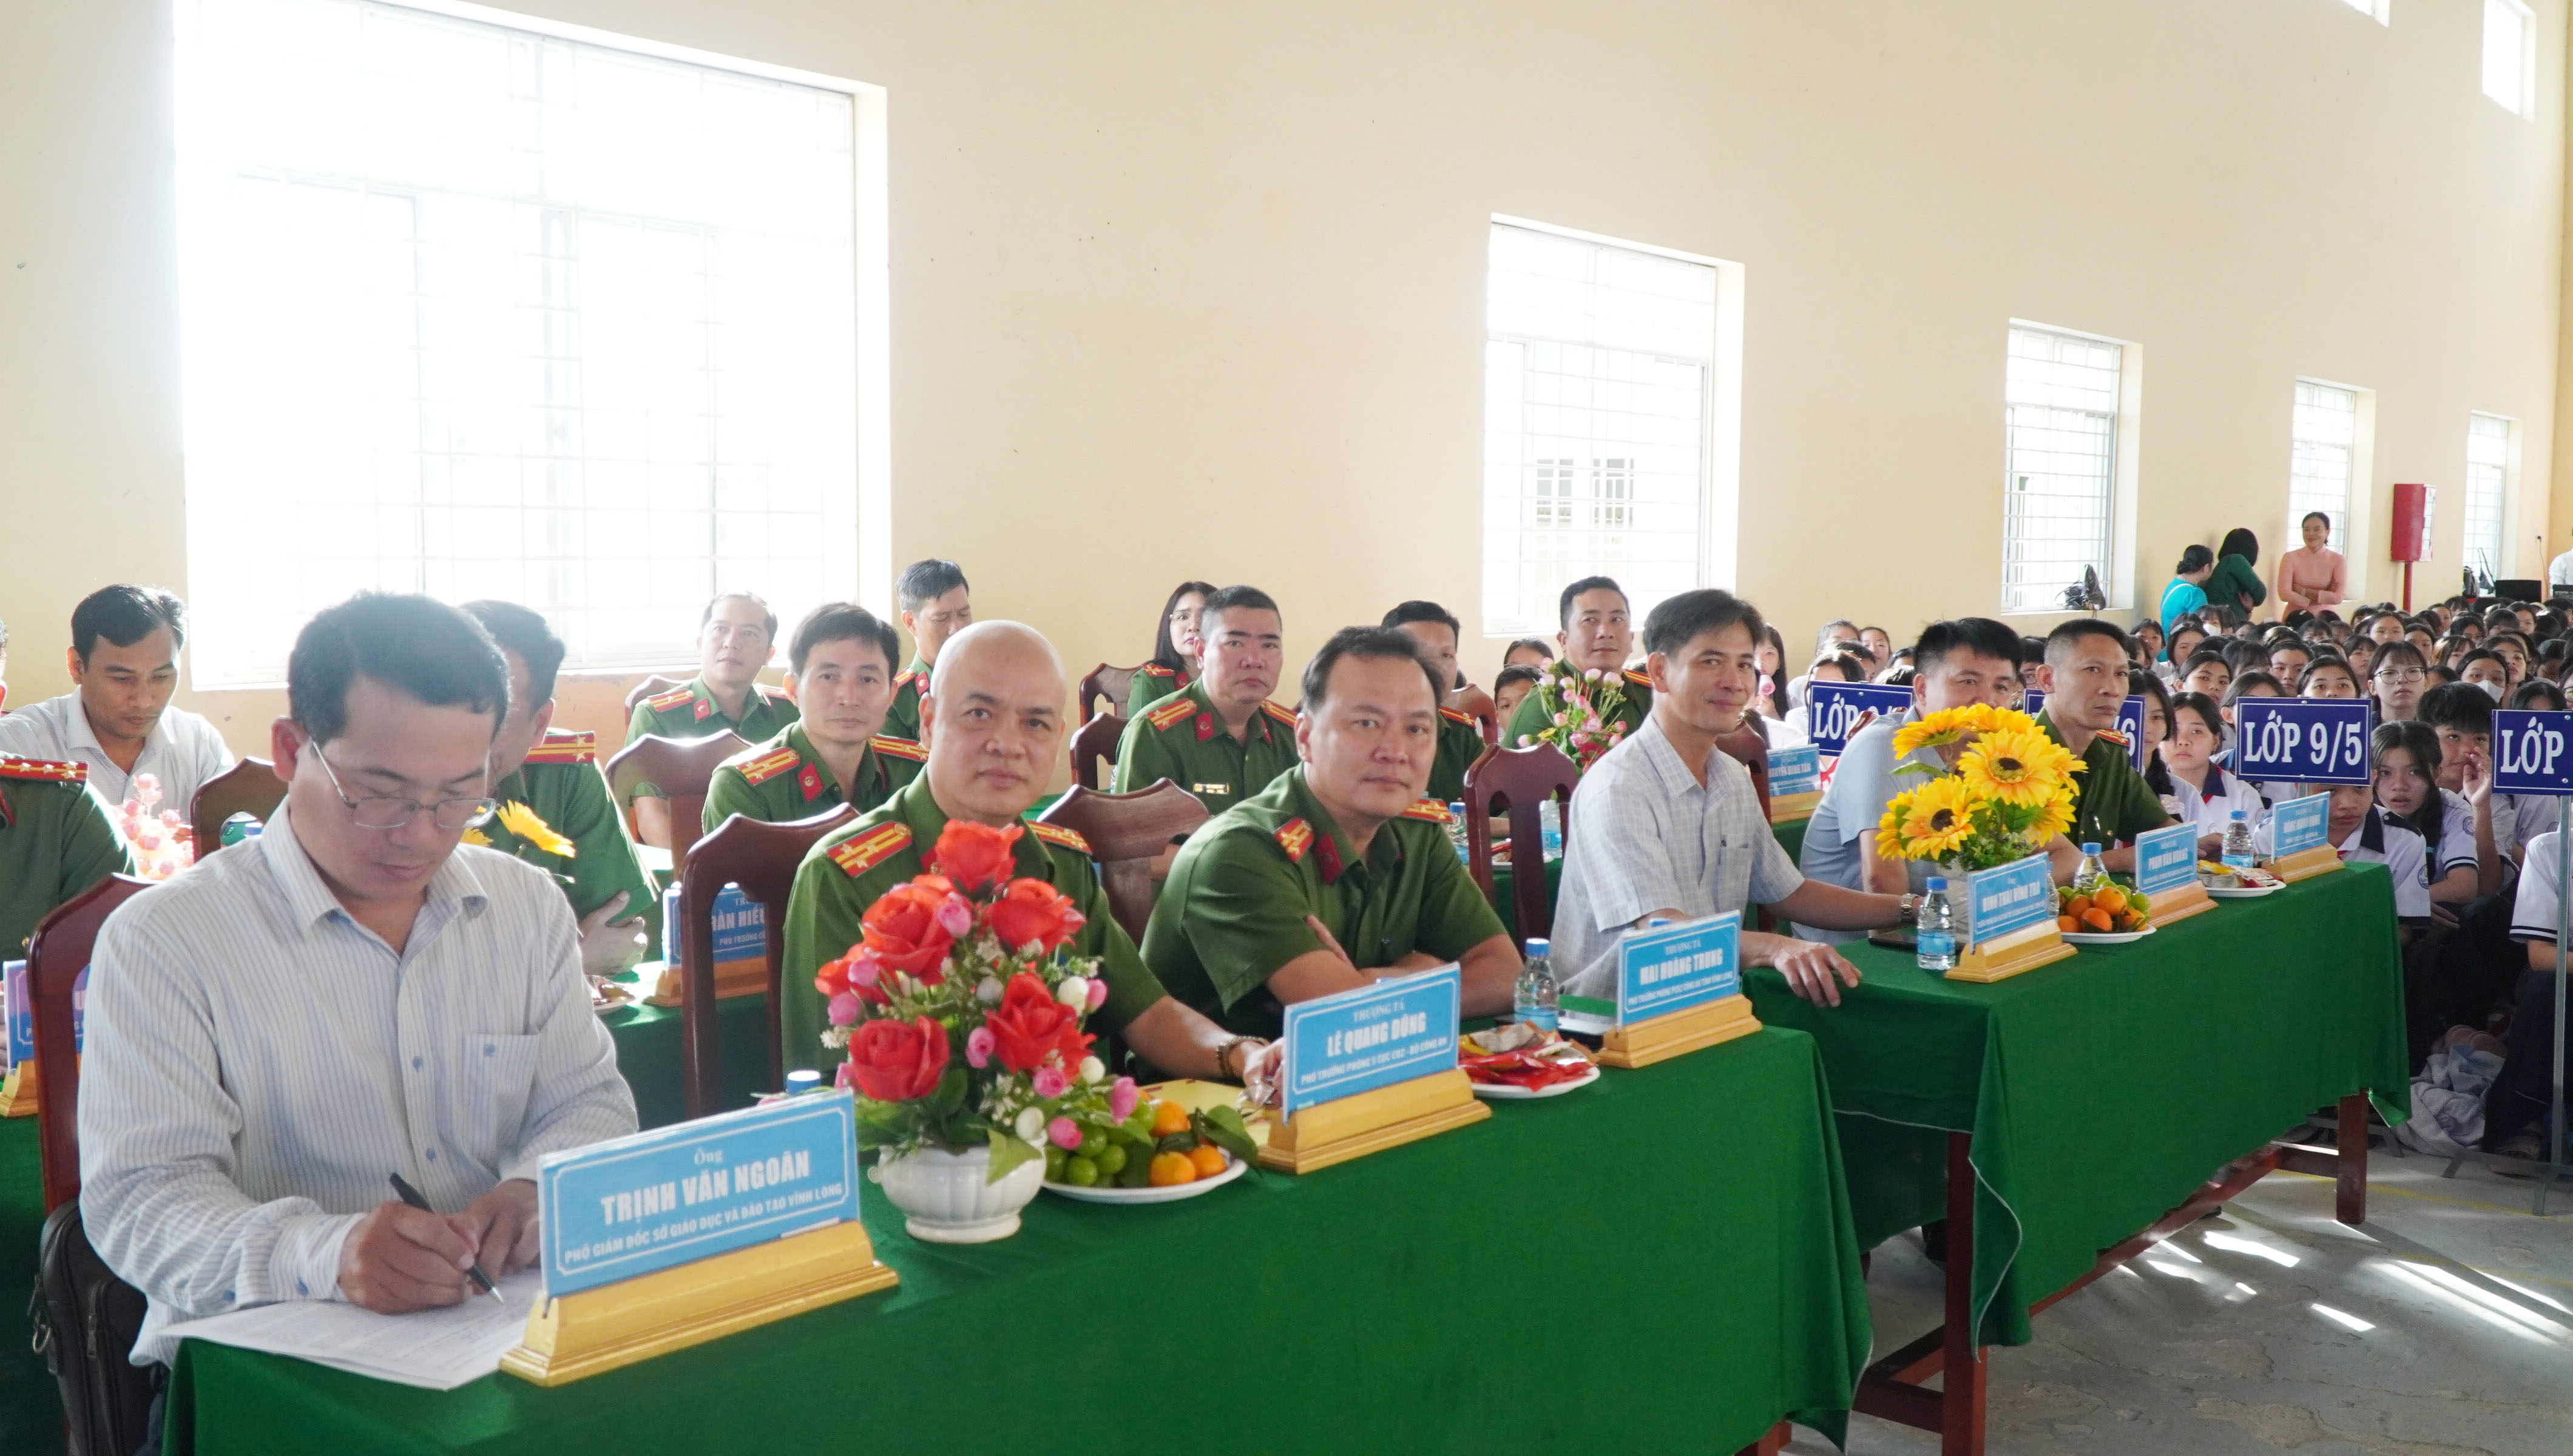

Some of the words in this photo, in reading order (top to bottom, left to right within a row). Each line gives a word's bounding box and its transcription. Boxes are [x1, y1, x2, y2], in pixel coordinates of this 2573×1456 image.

[1813, 692, 1859, 740] LỚP
[2245, 709, 2301, 763] LỚP
[2310, 721, 2362, 773] 9/5
[2500, 716, 2564, 774] LỚP
[1640, 964, 1658, 985] MAI
[1660, 956, 1691, 980] HOÀNG
[1693, 948, 1723, 971] TRUNG
[1353, 1003, 1391, 1022] THƯỢNG
[1393, 997, 1405, 1011] TÁ
[1344, 1022, 1389, 1055] QUANG
[694, 1147, 723, 1165] Ông
[601, 1181, 676, 1225] TRỊNH
[682, 1169, 728, 1205] VĂN
[734, 1150, 810, 1193] NGOÂN
[565, 1244, 590, 1264] PHÓ
[593, 1237, 623, 1257] GIÁM
[626, 1230, 650, 1249] ĐỐC
[652, 1224, 668, 1242] SỞ
[671, 1218, 697, 1238] GIÁO
[699, 1213, 722, 1230] DỤC
[725, 1206, 739, 1223] VÀ
[765, 1196, 786, 1213] TẠO
[788, 1190, 813, 1207] VĨNH
[815, 1182, 842, 1199] LONG
